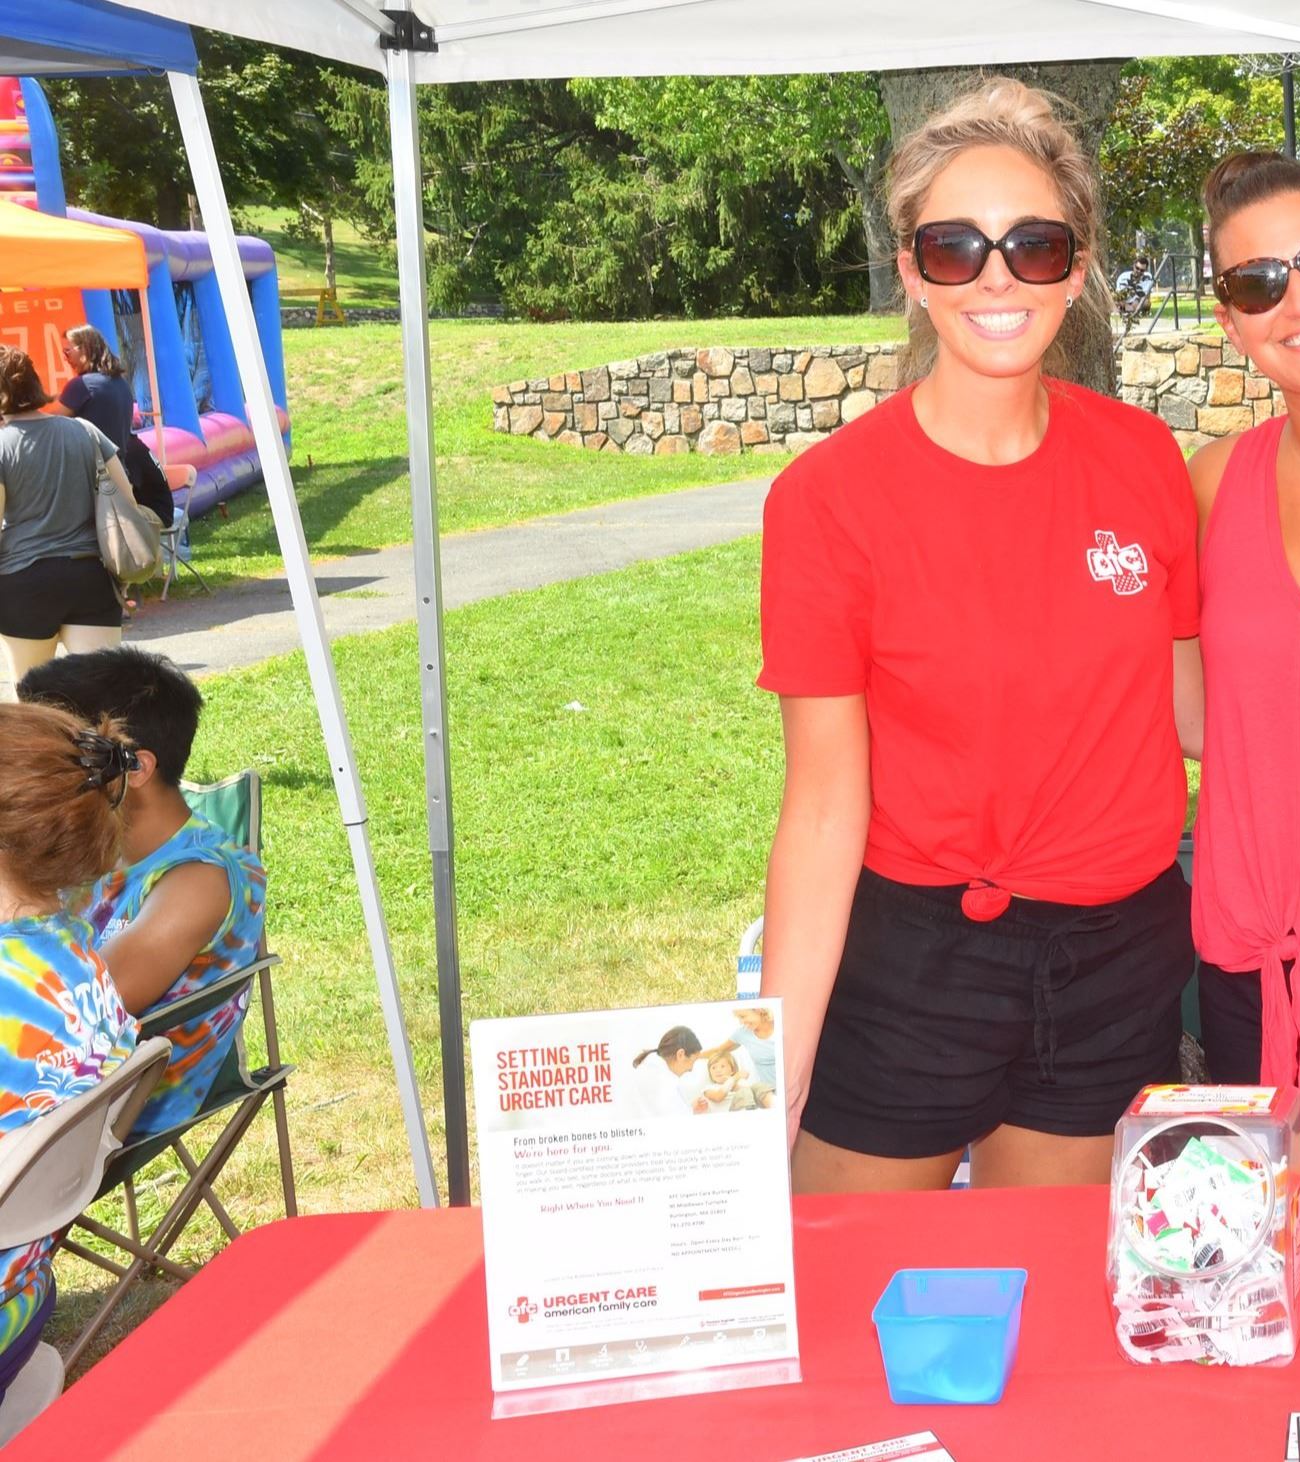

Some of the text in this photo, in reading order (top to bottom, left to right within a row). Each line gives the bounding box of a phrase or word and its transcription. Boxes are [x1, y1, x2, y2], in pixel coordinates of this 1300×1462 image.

[0, 298, 63, 315] E'D
[497, 1043, 610, 1069] SETTING THE
[499, 1064, 611, 1090] STANDARD IN
[500, 1085, 612, 1111] URGENT CARE
[514, 1137, 536, 1146] From
[539, 1134, 568, 1144] broken
[572, 1132, 596, 1142] bones
[600, 1131, 608, 1139] to
[572, 1145, 587, 1153] for
[543, 1290, 610, 1309] URGENT
[615, 1286, 657, 1300] CARE
[544, 1299, 657, 1318] american family care
